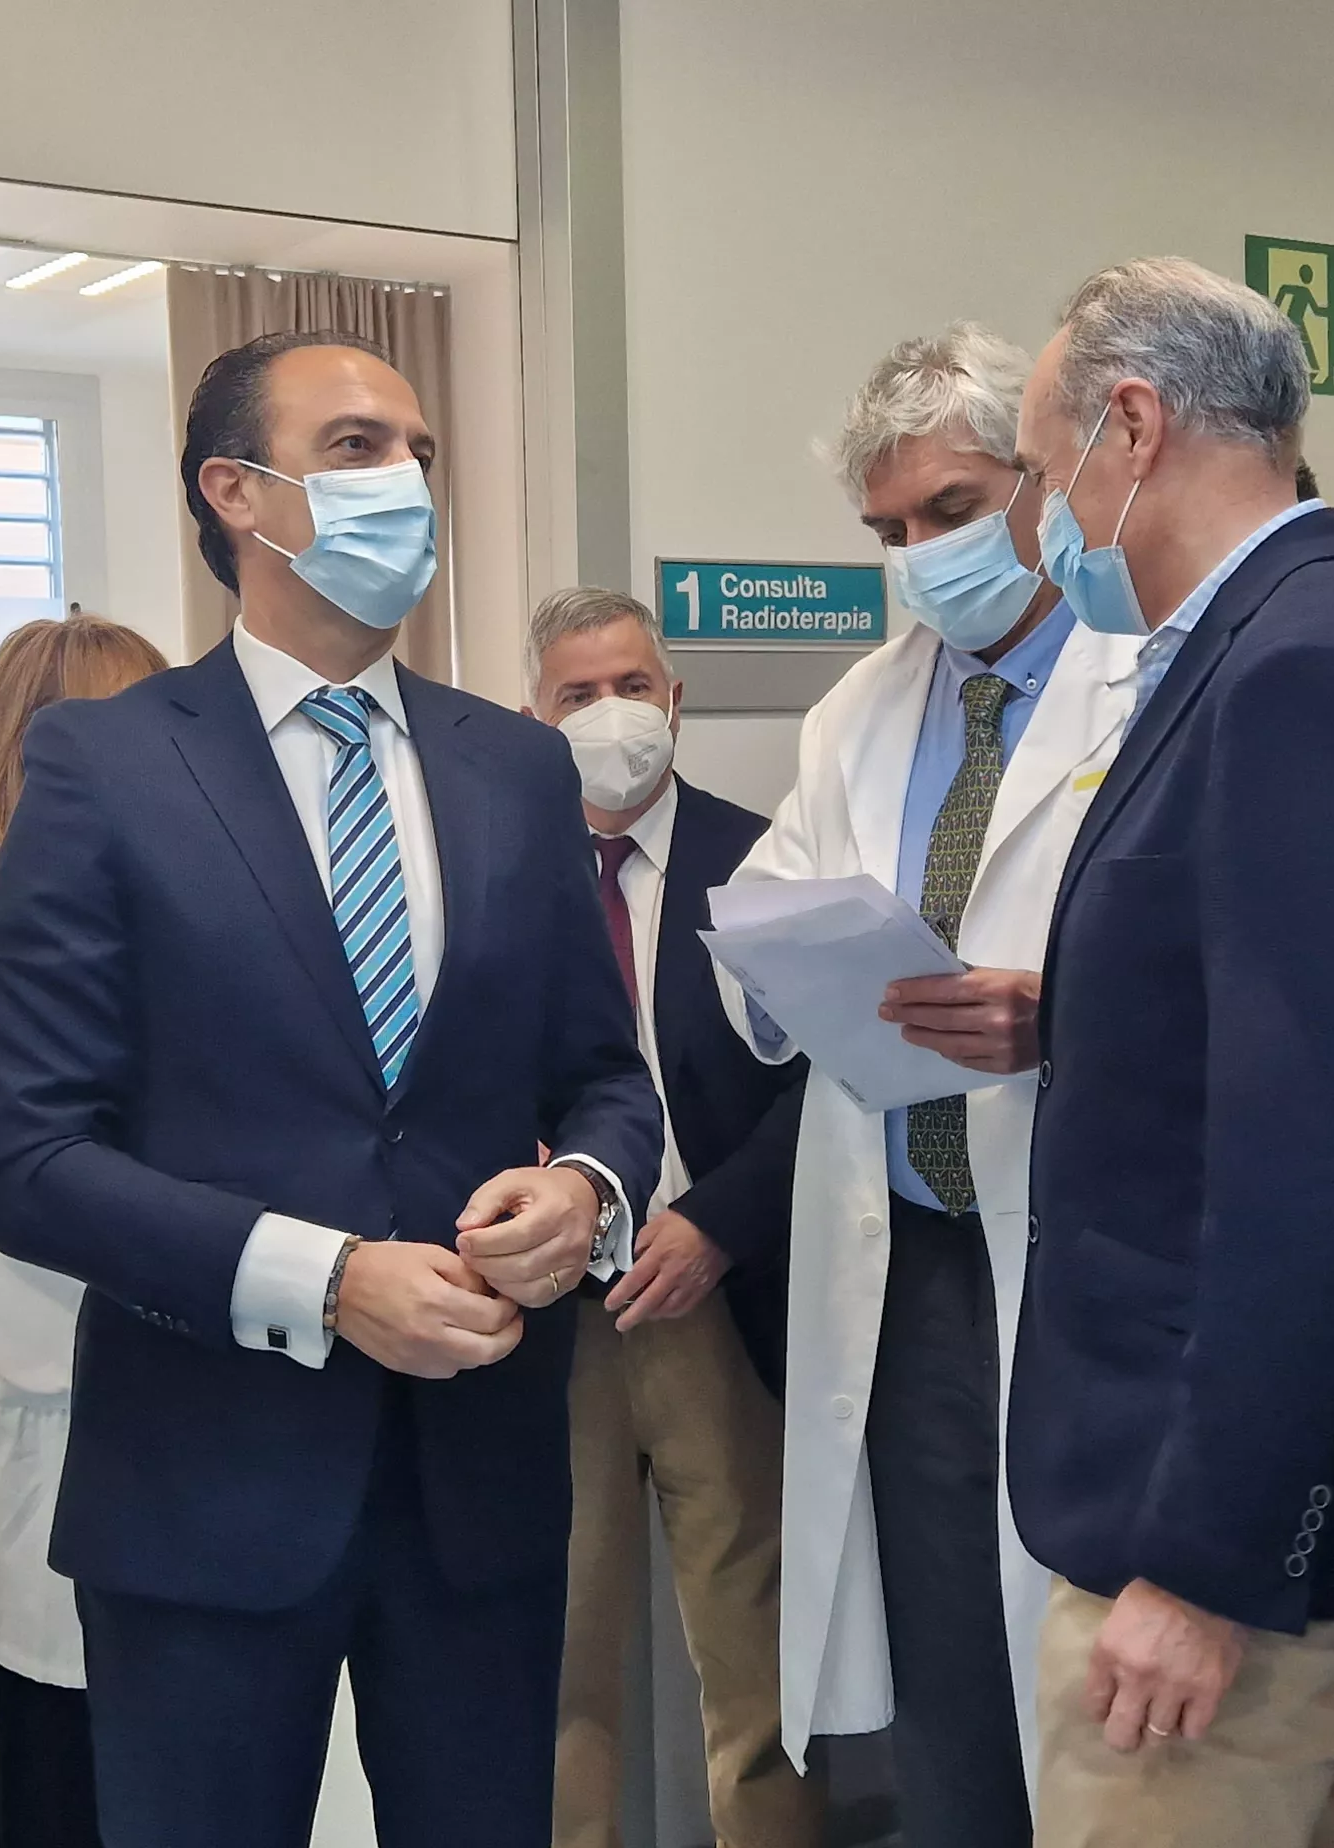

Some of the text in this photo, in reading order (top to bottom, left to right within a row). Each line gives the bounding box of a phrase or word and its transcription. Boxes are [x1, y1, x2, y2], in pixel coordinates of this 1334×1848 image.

[720, 573, 827, 598] Consulta
[676, 571, 700, 630] 1
[721, 605, 872, 634] Radioterapia
